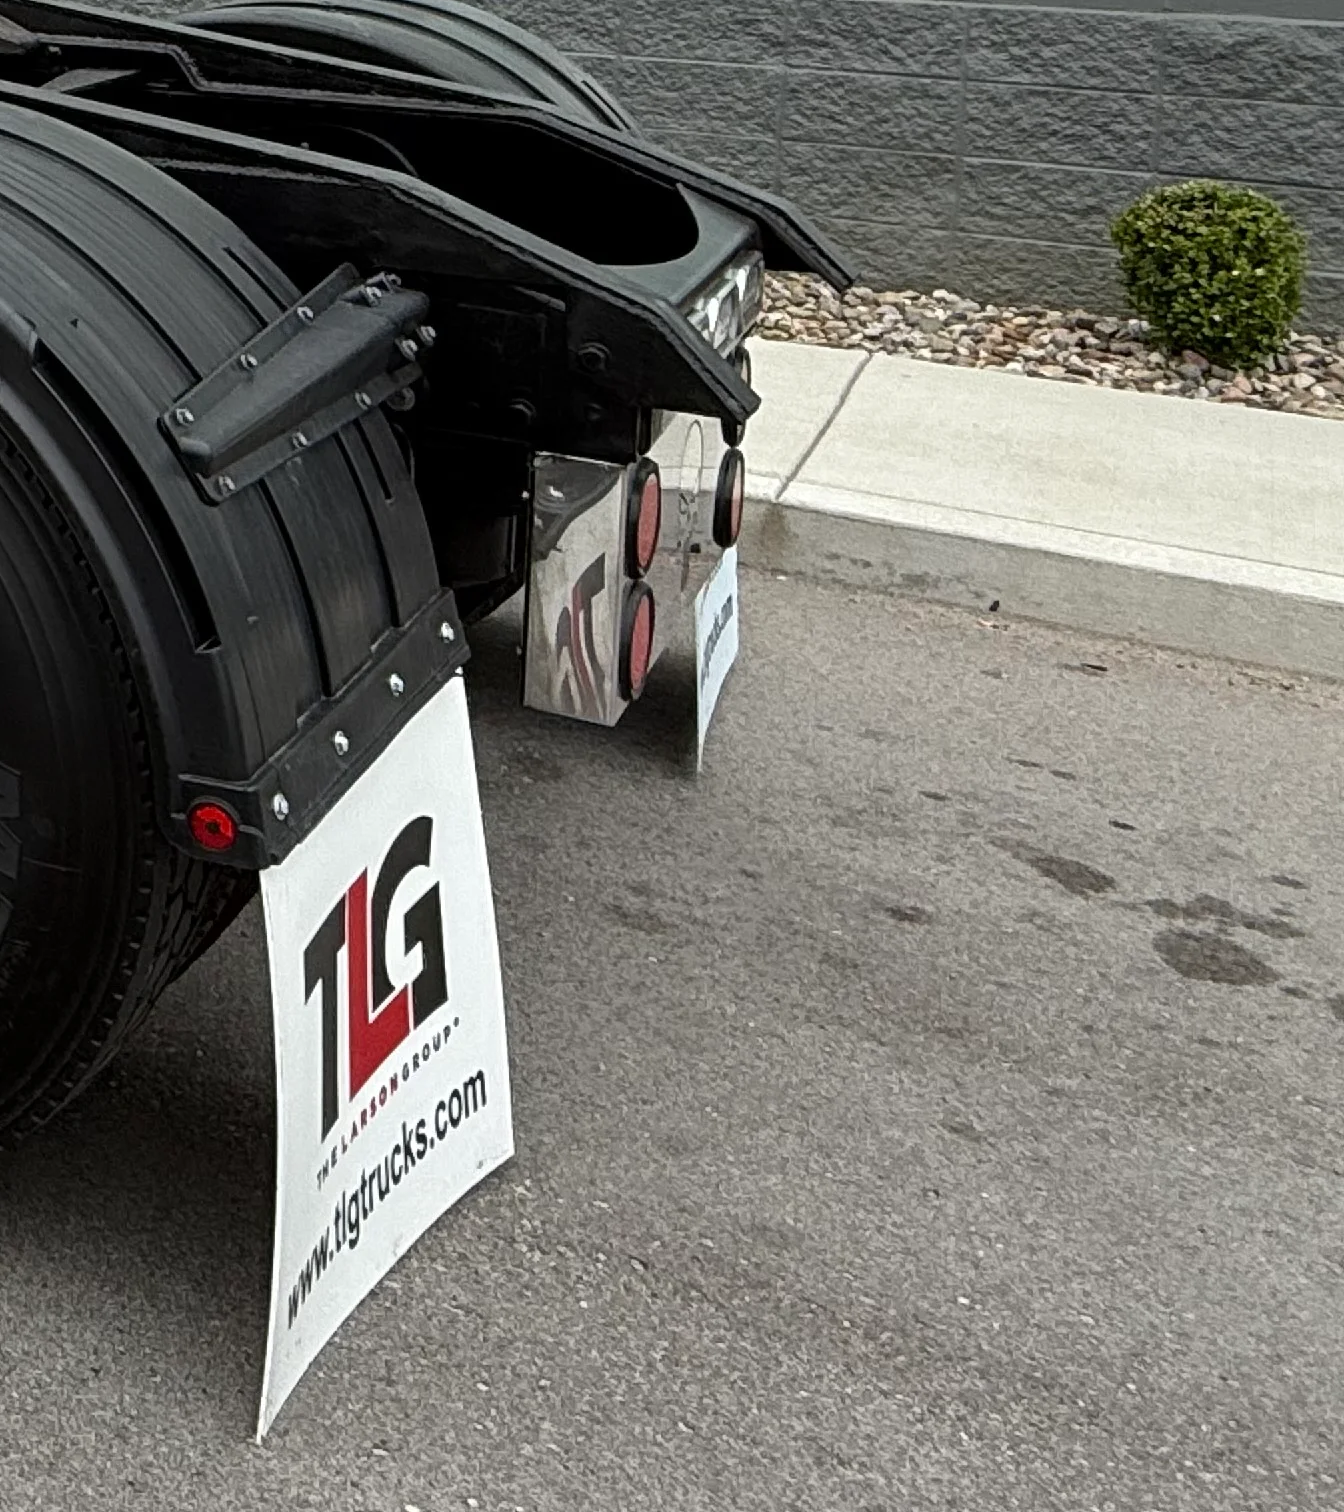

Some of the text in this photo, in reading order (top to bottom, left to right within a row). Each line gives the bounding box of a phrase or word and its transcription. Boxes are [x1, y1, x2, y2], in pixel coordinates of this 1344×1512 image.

[303, 814, 449, 1144] TLG
[316, 1024, 452, 1191] THE LARSON GROUP
[287, 1068, 487, 1330] www.tlgtrucks.com
